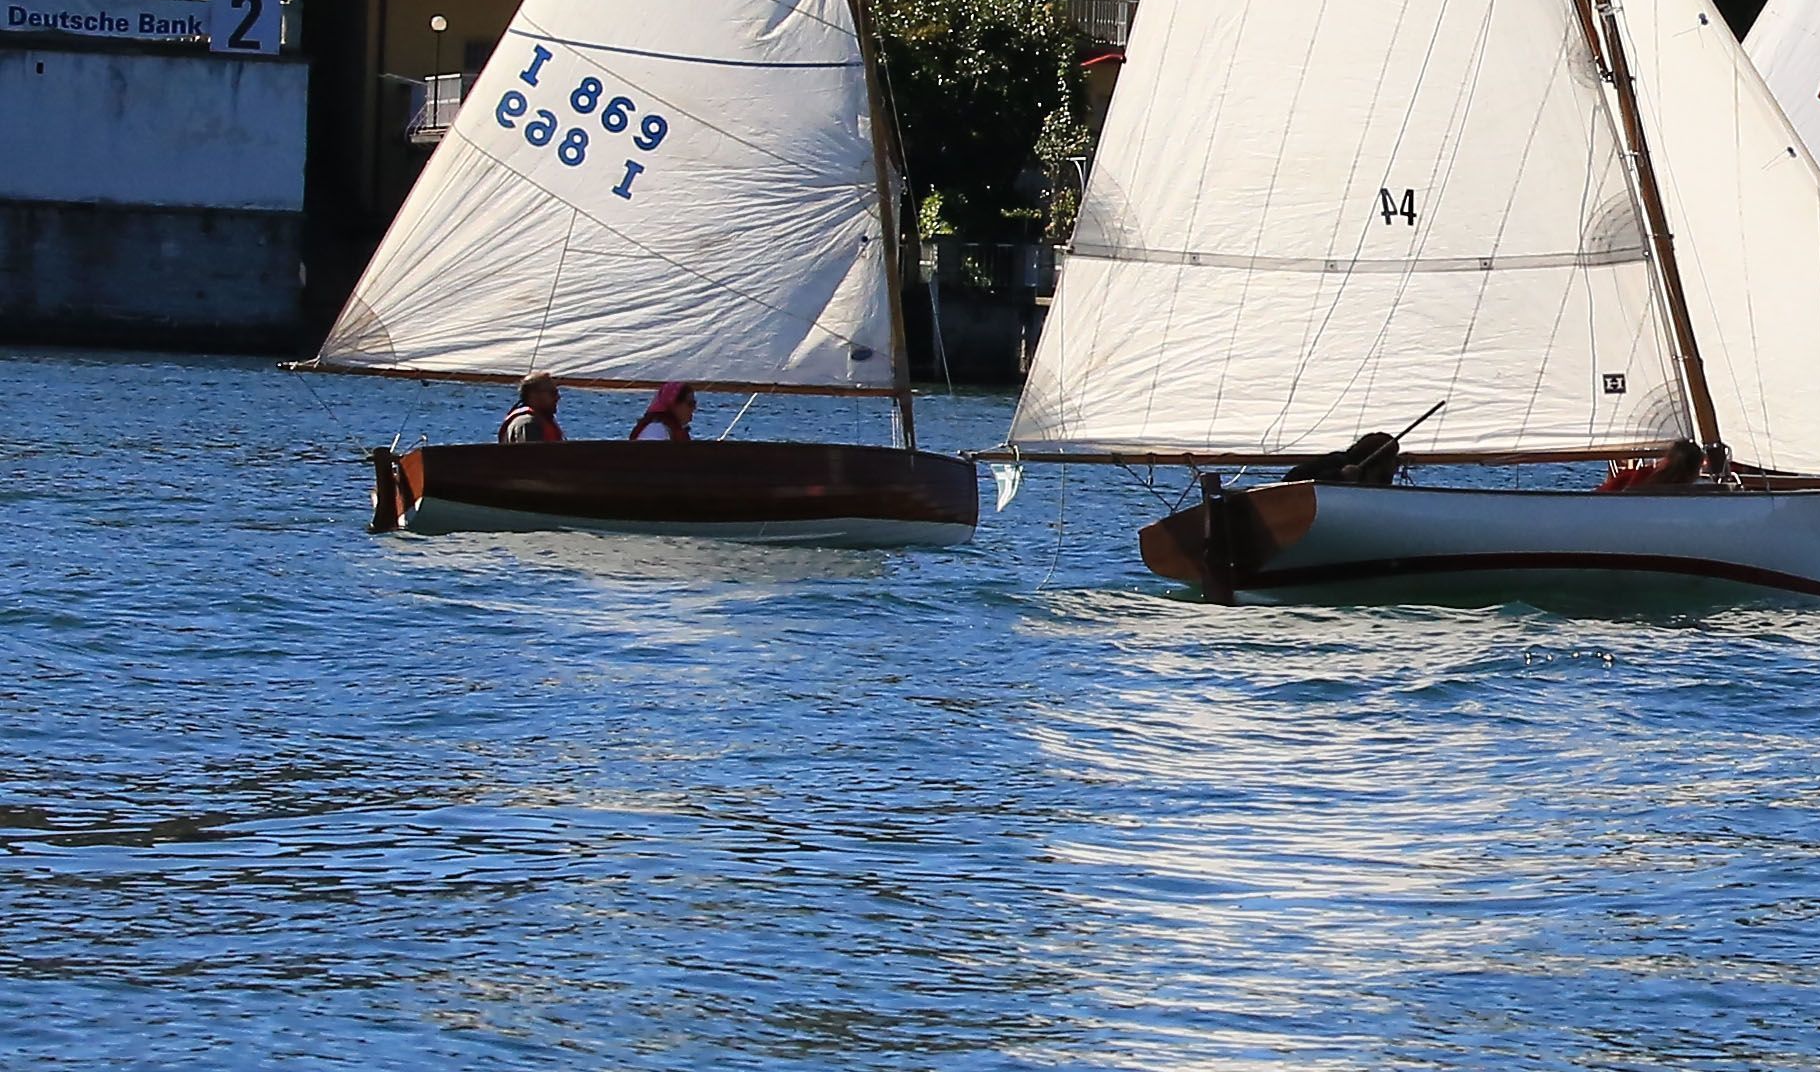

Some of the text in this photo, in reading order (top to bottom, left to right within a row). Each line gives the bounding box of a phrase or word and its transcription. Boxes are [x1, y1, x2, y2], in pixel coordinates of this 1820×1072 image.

[8, 5, 202, 35] Deutsche Bank
[570, 77, 669, 151] 869
